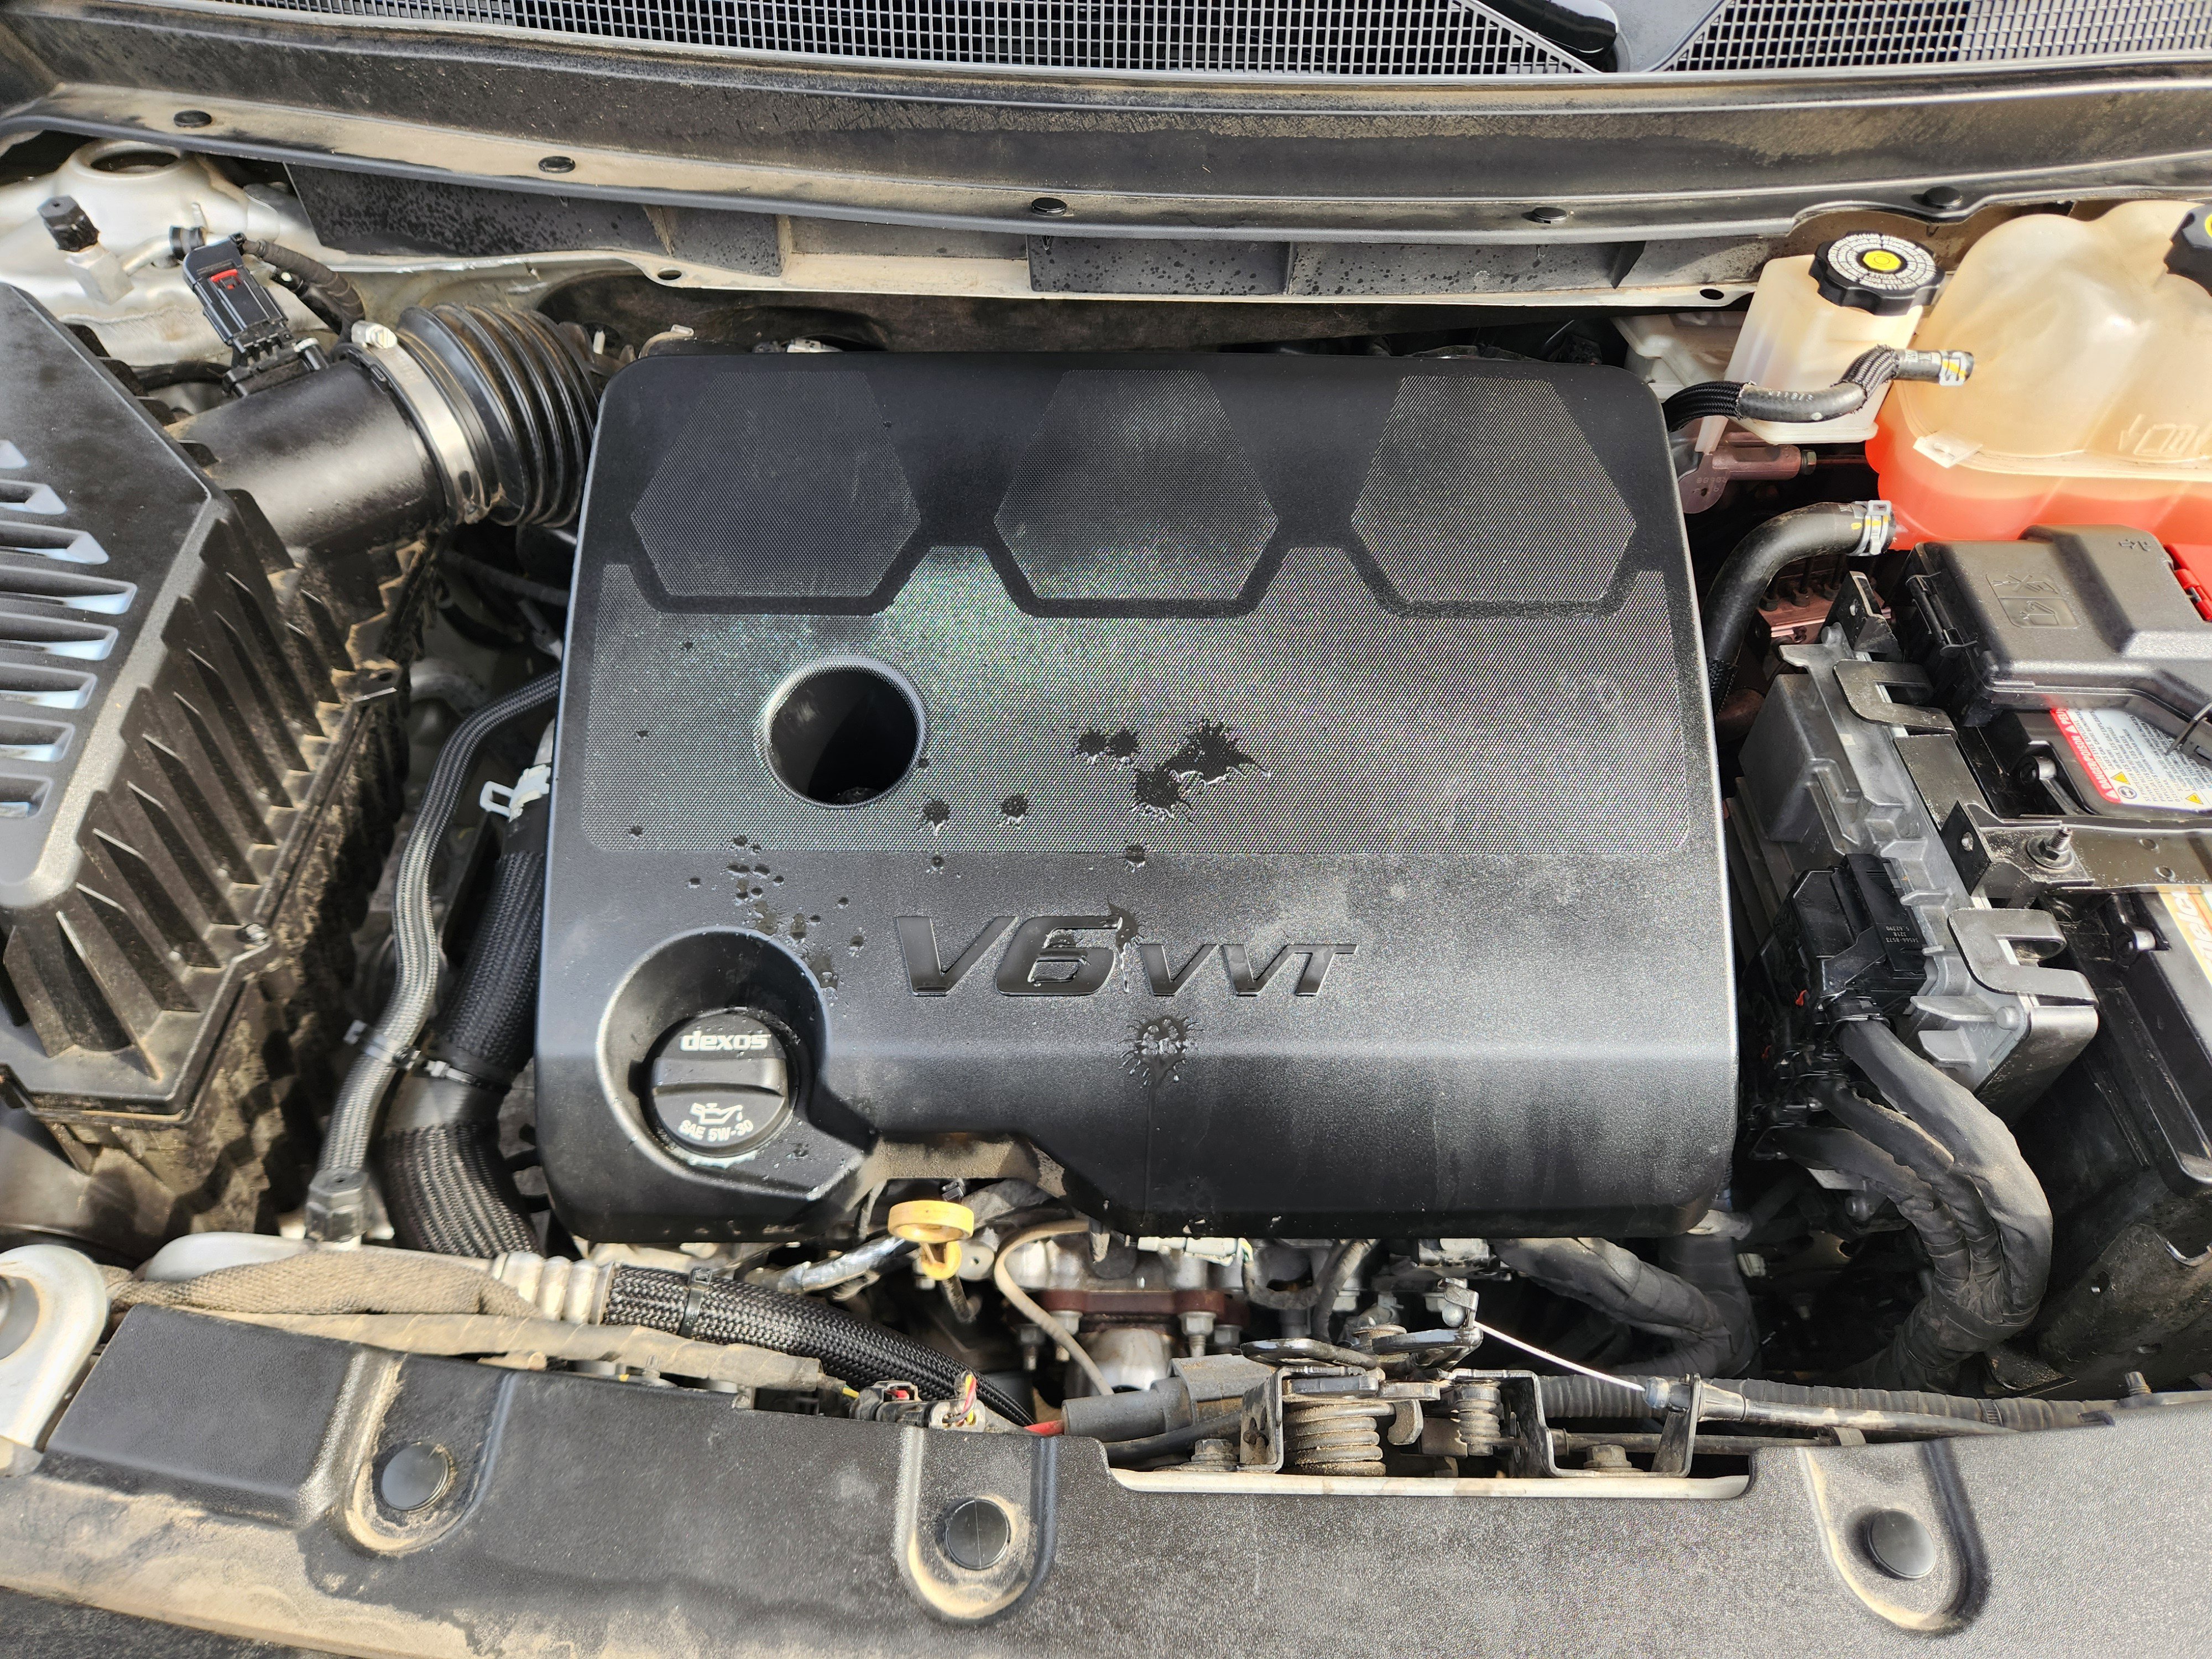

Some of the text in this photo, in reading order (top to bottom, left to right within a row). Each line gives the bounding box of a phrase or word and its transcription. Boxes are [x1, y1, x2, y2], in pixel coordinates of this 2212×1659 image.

[896, 915, 1359, 997] V6 VVT
[680, 1030, 771, 1052] dexos
[678, 1119, 754, 1142] SAE 5W-30
